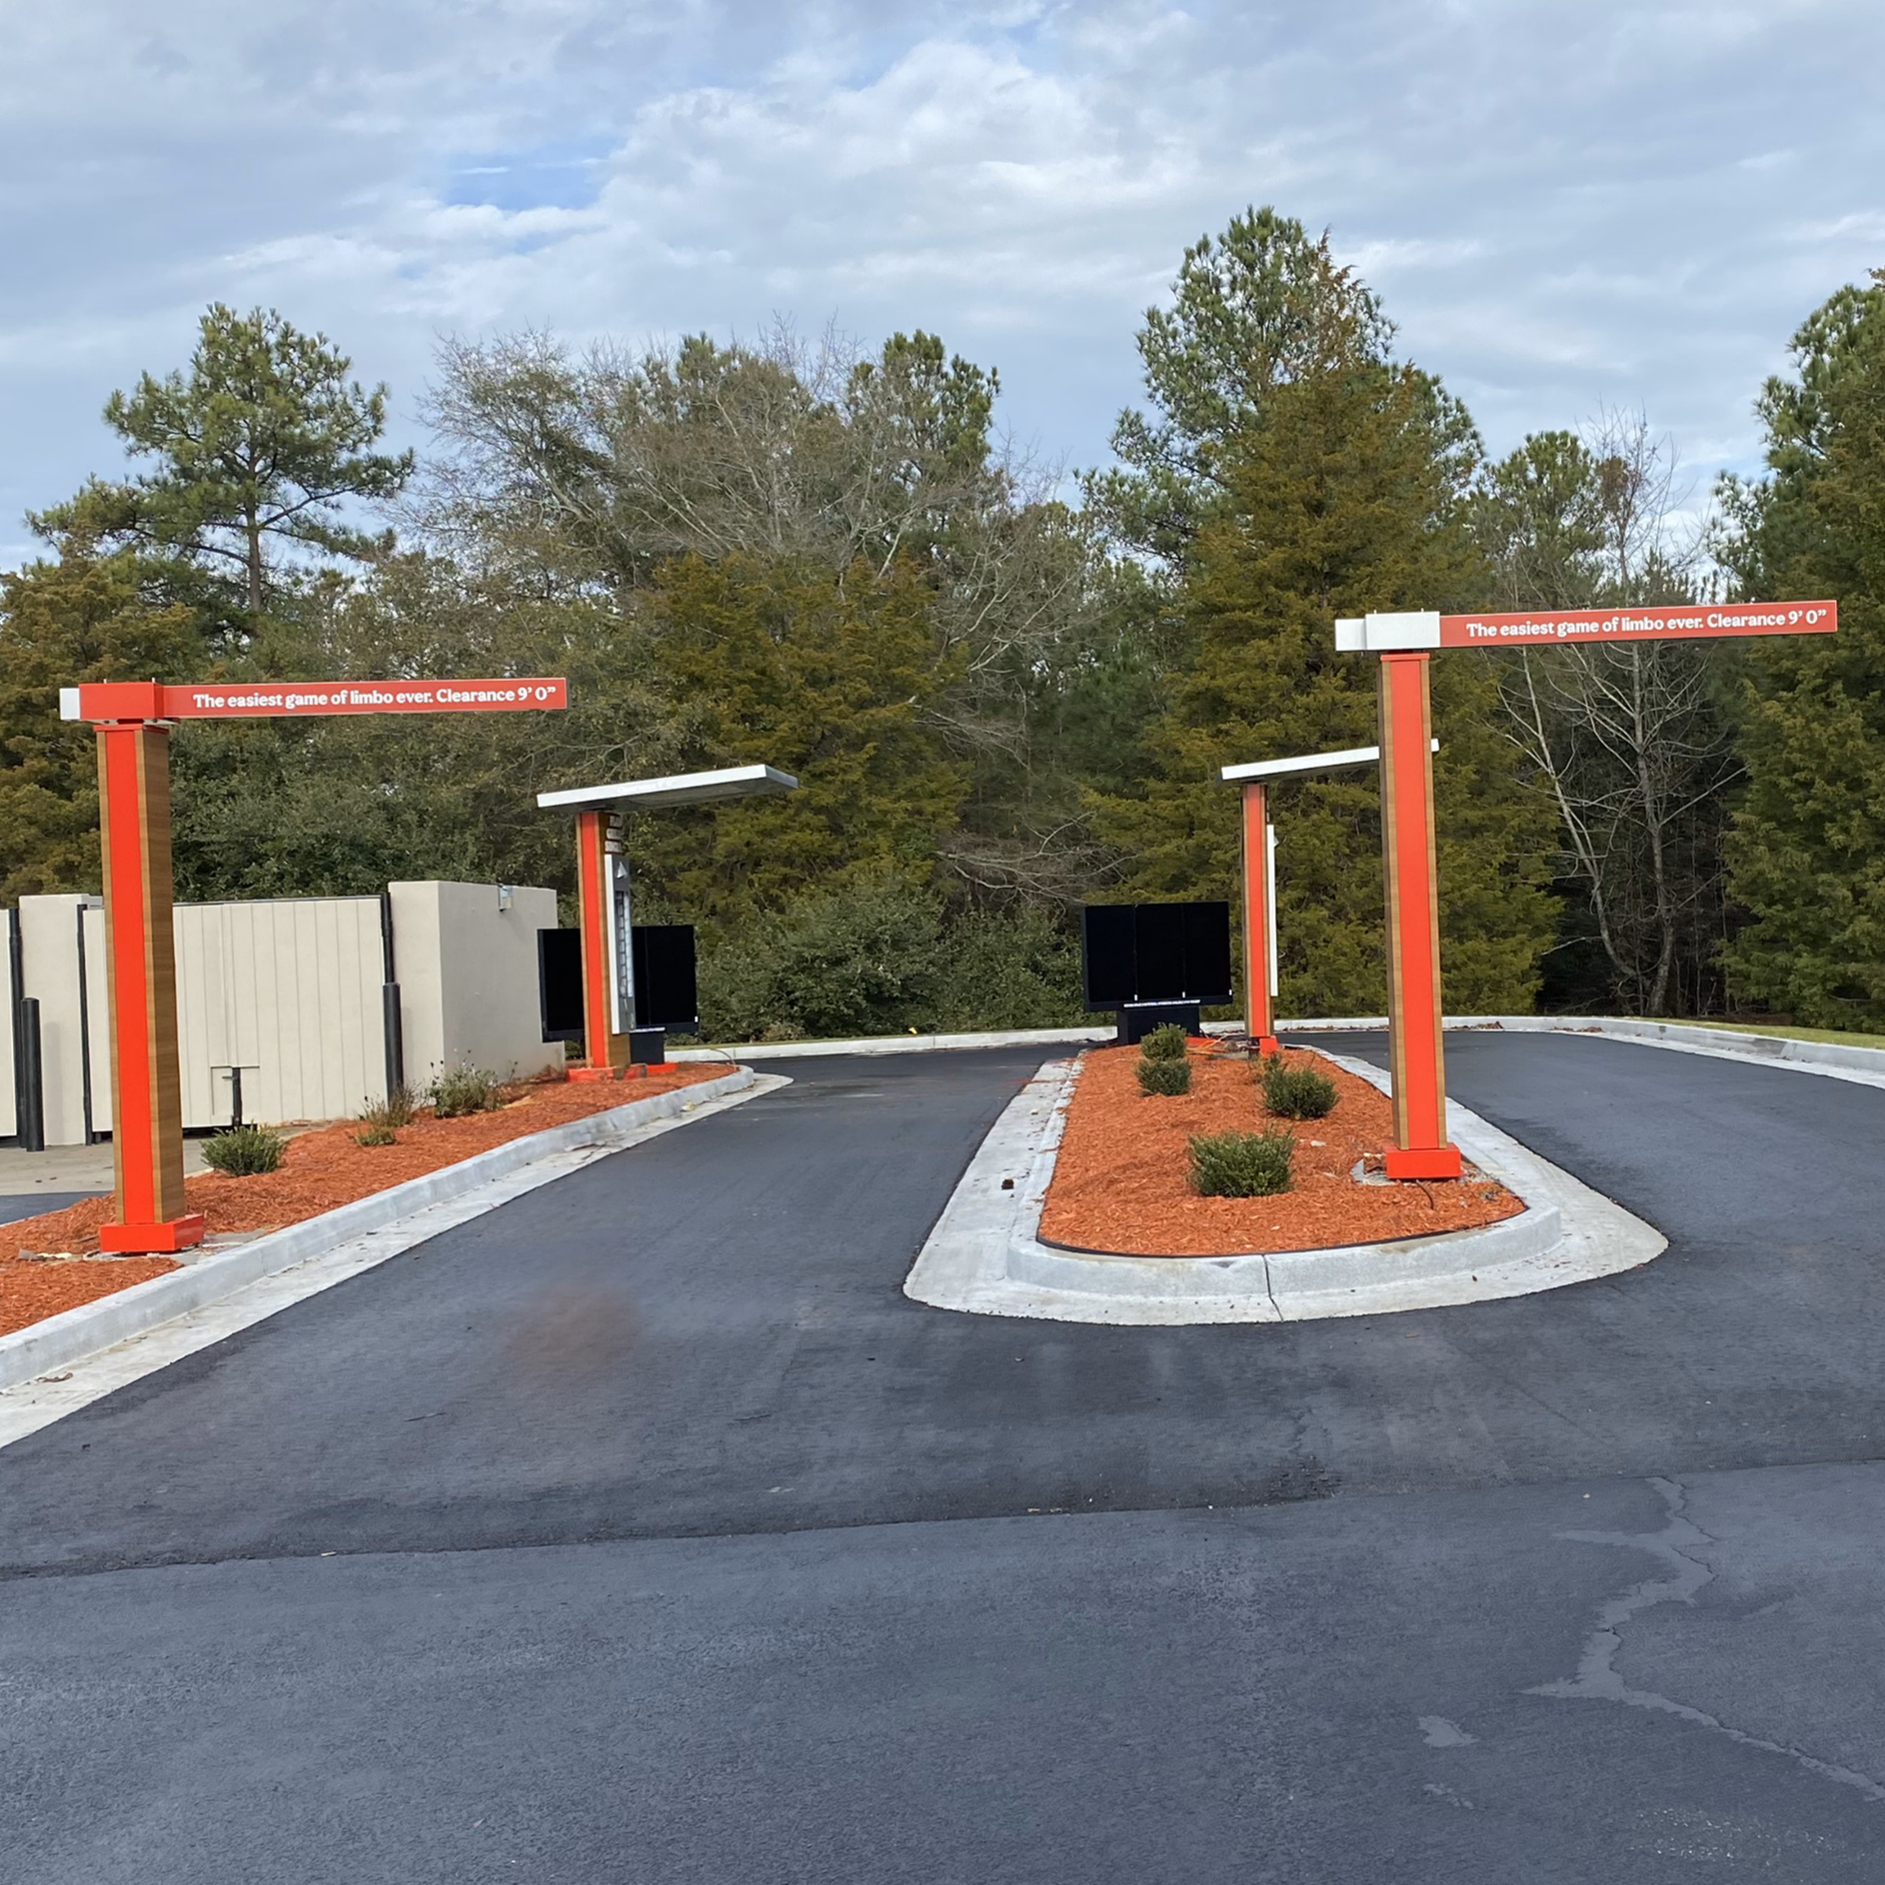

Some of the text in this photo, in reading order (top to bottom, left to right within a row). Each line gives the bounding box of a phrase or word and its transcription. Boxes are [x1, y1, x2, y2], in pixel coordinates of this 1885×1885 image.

[1466, 621, 1497, 637] The
[1500, 620, 1555, 636] easiest
[1557, 620, 1600, 637] game
[1602, 616, 1619, 632] of
[1621, 616, 1664, 631] limbo
[1667, 617, 1704, 630] ever.
[1707, 613, 1786, 628] Clearance
[193, 693, 225, 708] The
[227, 692, 283, 707] easiest
[285, 694, 328, 709] game
[330, 689, 348, 705] of
[350, 689, 394, 704] limbo
[396, 691, 434, 704] ever.
[436, 689, 515, 703] Clearance
